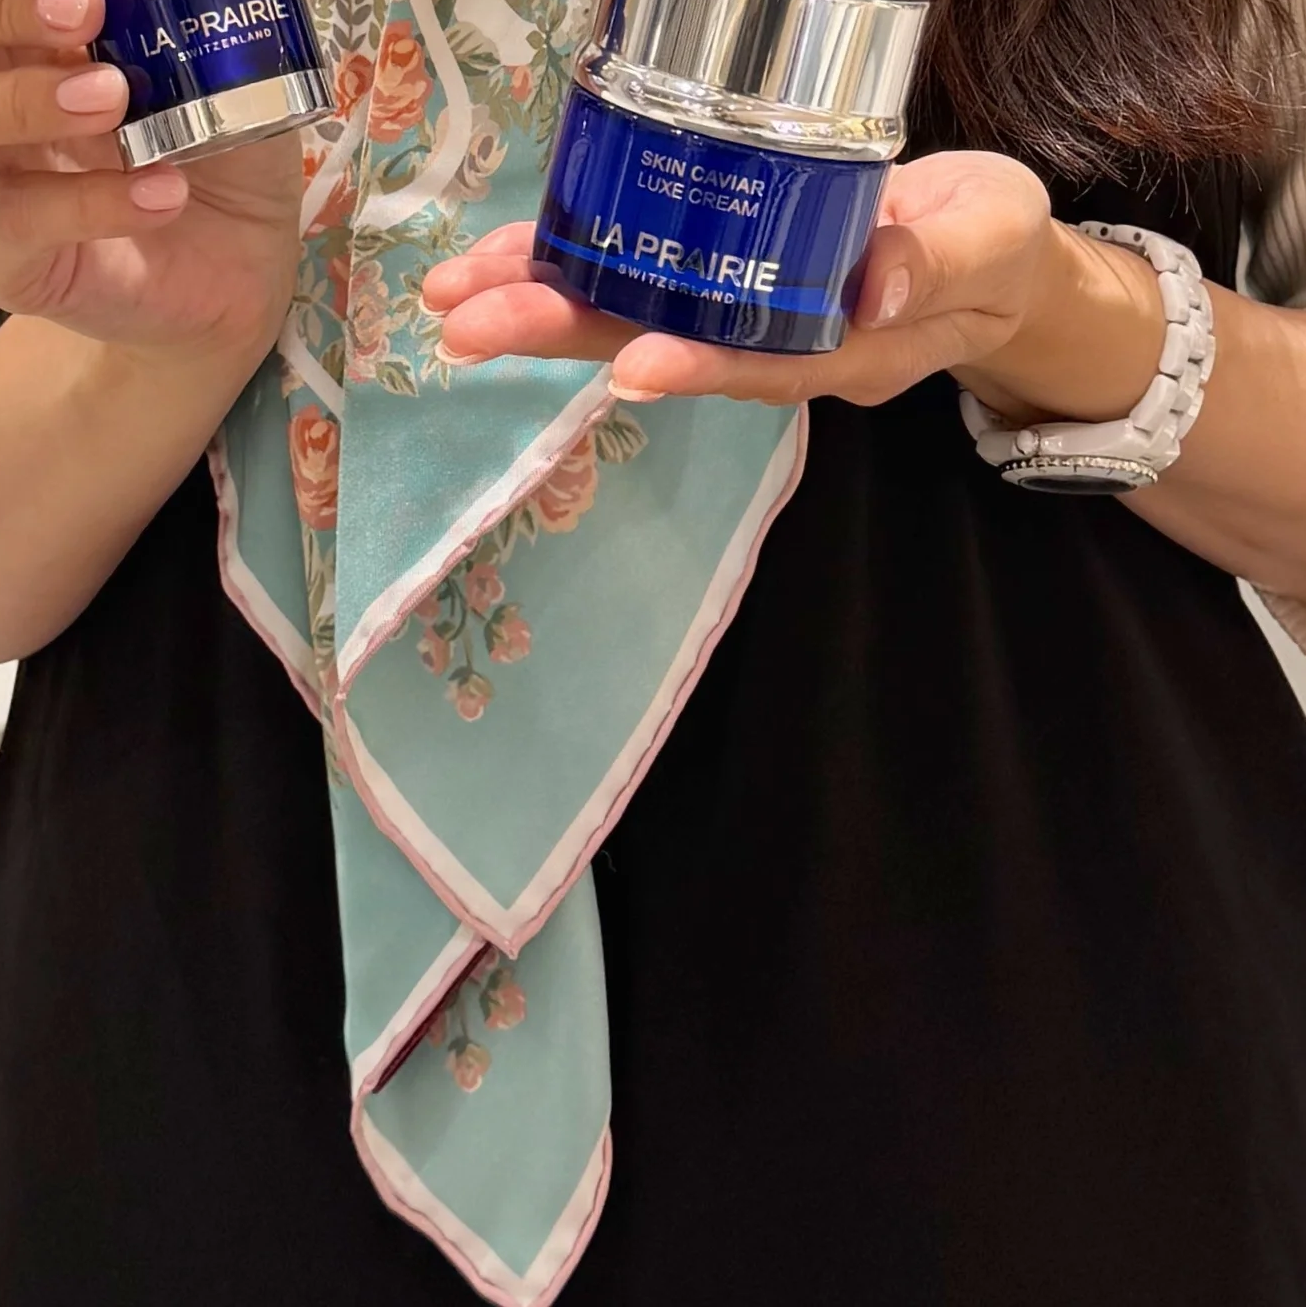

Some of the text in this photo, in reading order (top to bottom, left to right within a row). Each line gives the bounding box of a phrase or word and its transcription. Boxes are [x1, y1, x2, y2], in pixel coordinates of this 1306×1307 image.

[140, 26, 176, 58] LA
[178, 28, 272, 62] SWITZERLAND
[636, 171, 760, 219] LUXE CREAM
[640, 149, 765, 198] SKIN CAVIAR
[590, 215, 781, 293] LA PRAIRIE
[617, 263, 735, 305] SWITZERLAND
